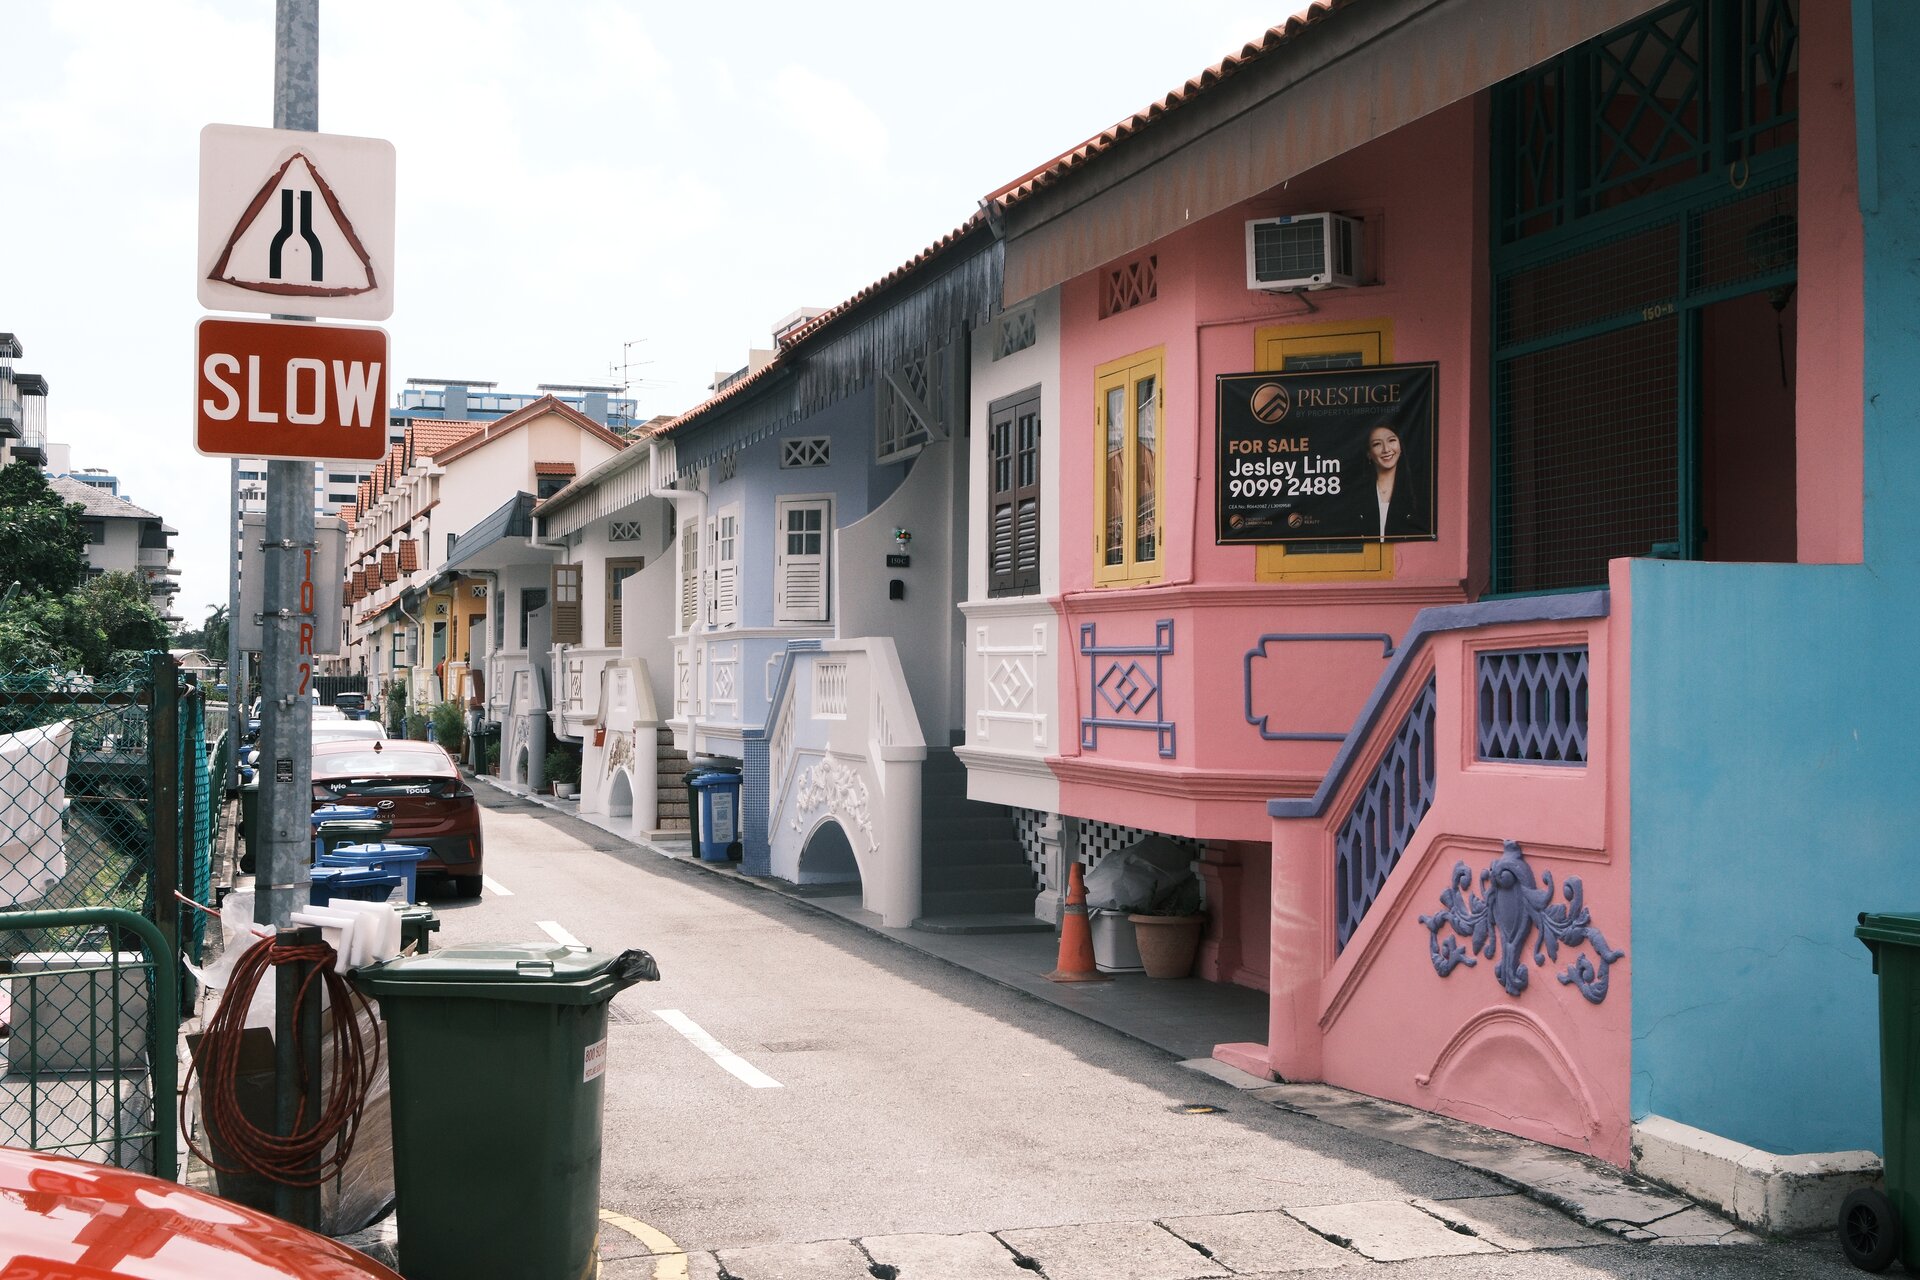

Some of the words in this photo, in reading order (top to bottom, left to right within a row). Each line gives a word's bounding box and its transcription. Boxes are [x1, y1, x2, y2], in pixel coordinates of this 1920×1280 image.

[203, 353, 381, 427] SLOW
[1297, 384, 1400, 407] PRESTIGE
[1229, 440, 1263, 454] FOR
[1268, 438, 1309, 453] SALE
[1229, 457, 1296, 480] Jesley
[1303, 455, 1341, 474] Lim
[1229, 478, 1282, 498] 9099
[1287, 476, 1341, 496] 2488
